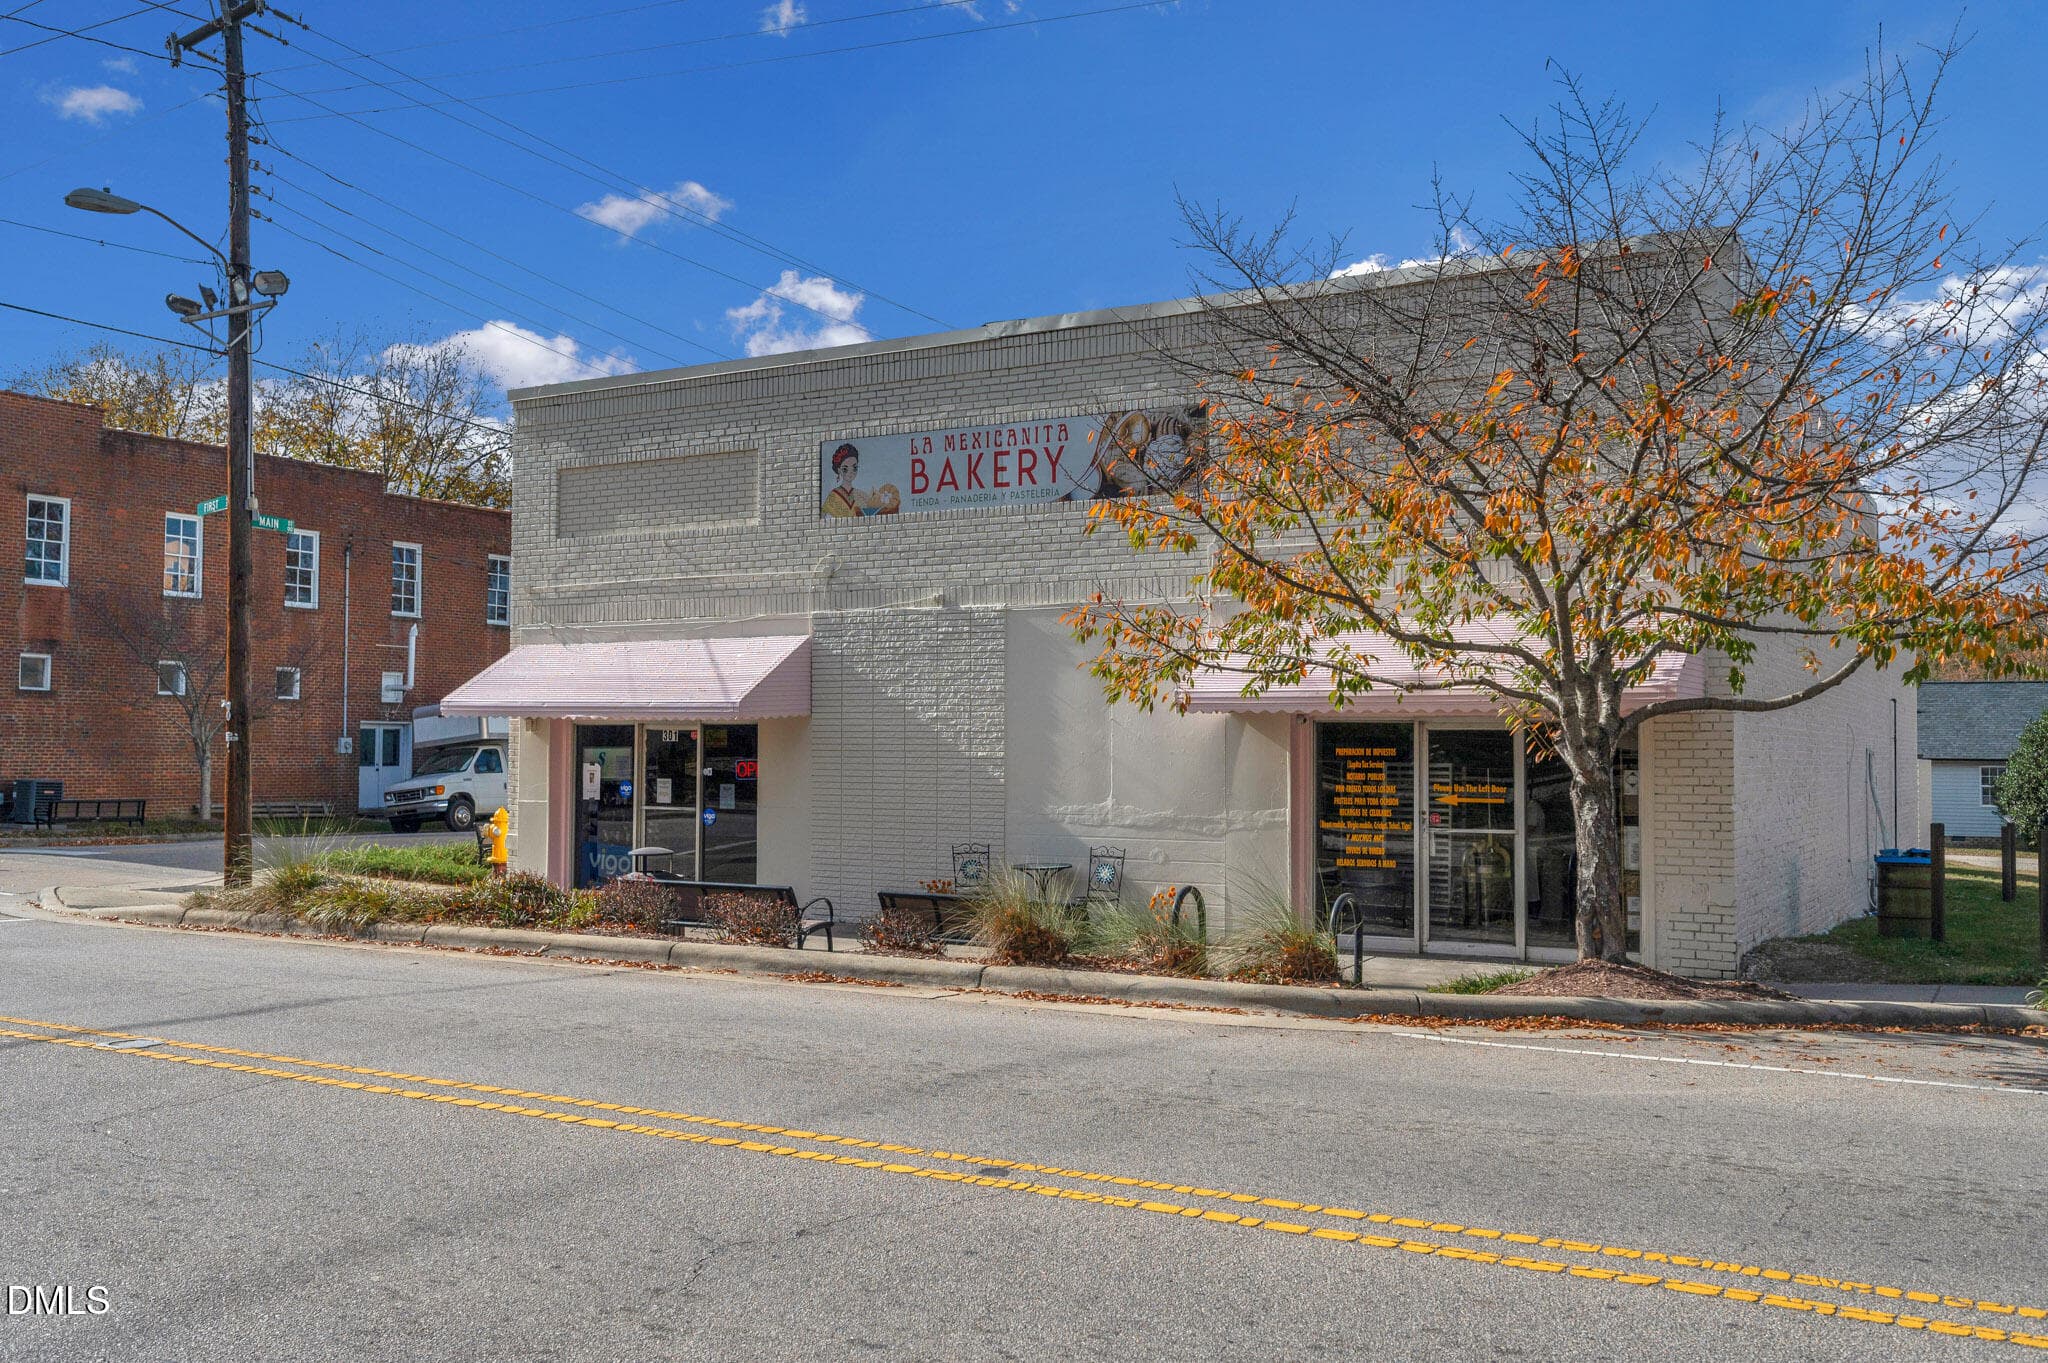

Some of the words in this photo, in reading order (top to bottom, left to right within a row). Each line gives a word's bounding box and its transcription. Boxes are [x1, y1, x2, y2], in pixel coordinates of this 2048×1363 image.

[911, 437, 933, 456] LA
[944, 423, 1069, 452] MEXICANITA
[911, 445, 1065, 494] BAKERY
[203, 500, 219, 513] FIRST
[912, 497, 939, 508] TIENDA
[1001, 492, 1007, 500] Y
[259, 516, 279, 529] MAIN
[663, 730, 678, 741] 301
[1362, 785, 1377, 793] TODOS
[1453, 784, 1464, 792] Use
[1465, 784, 1477, 793] The
[1478, 785, 1490, 793] Left
[1491, 785, 1507, 793] Door
[589, 848, 631, 875] vigo
